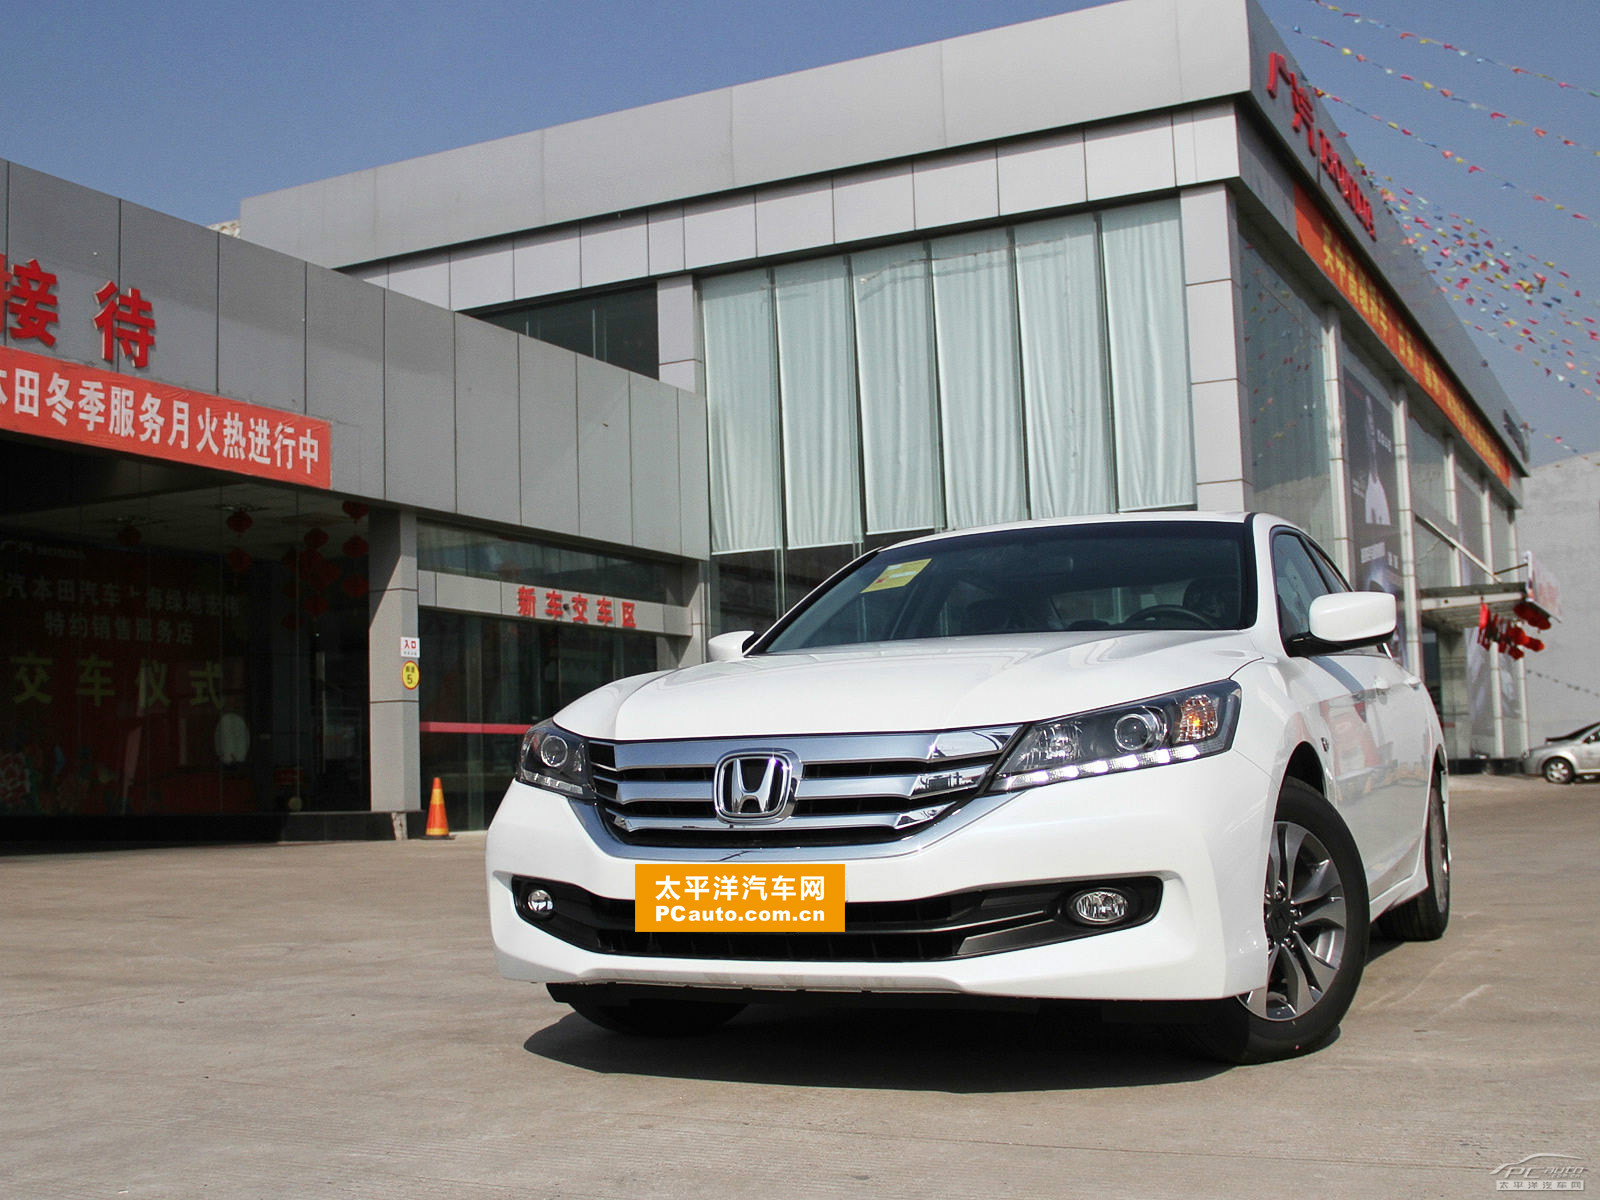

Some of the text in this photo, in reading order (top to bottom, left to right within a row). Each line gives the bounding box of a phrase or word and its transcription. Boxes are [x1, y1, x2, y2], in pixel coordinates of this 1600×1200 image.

[517, 586, 637, 629] 新车交车区
[404, 639, 417, 650] 入口
[9, 651, 226, 711] 交车仪式
[407, 673, 413, 685] 5
